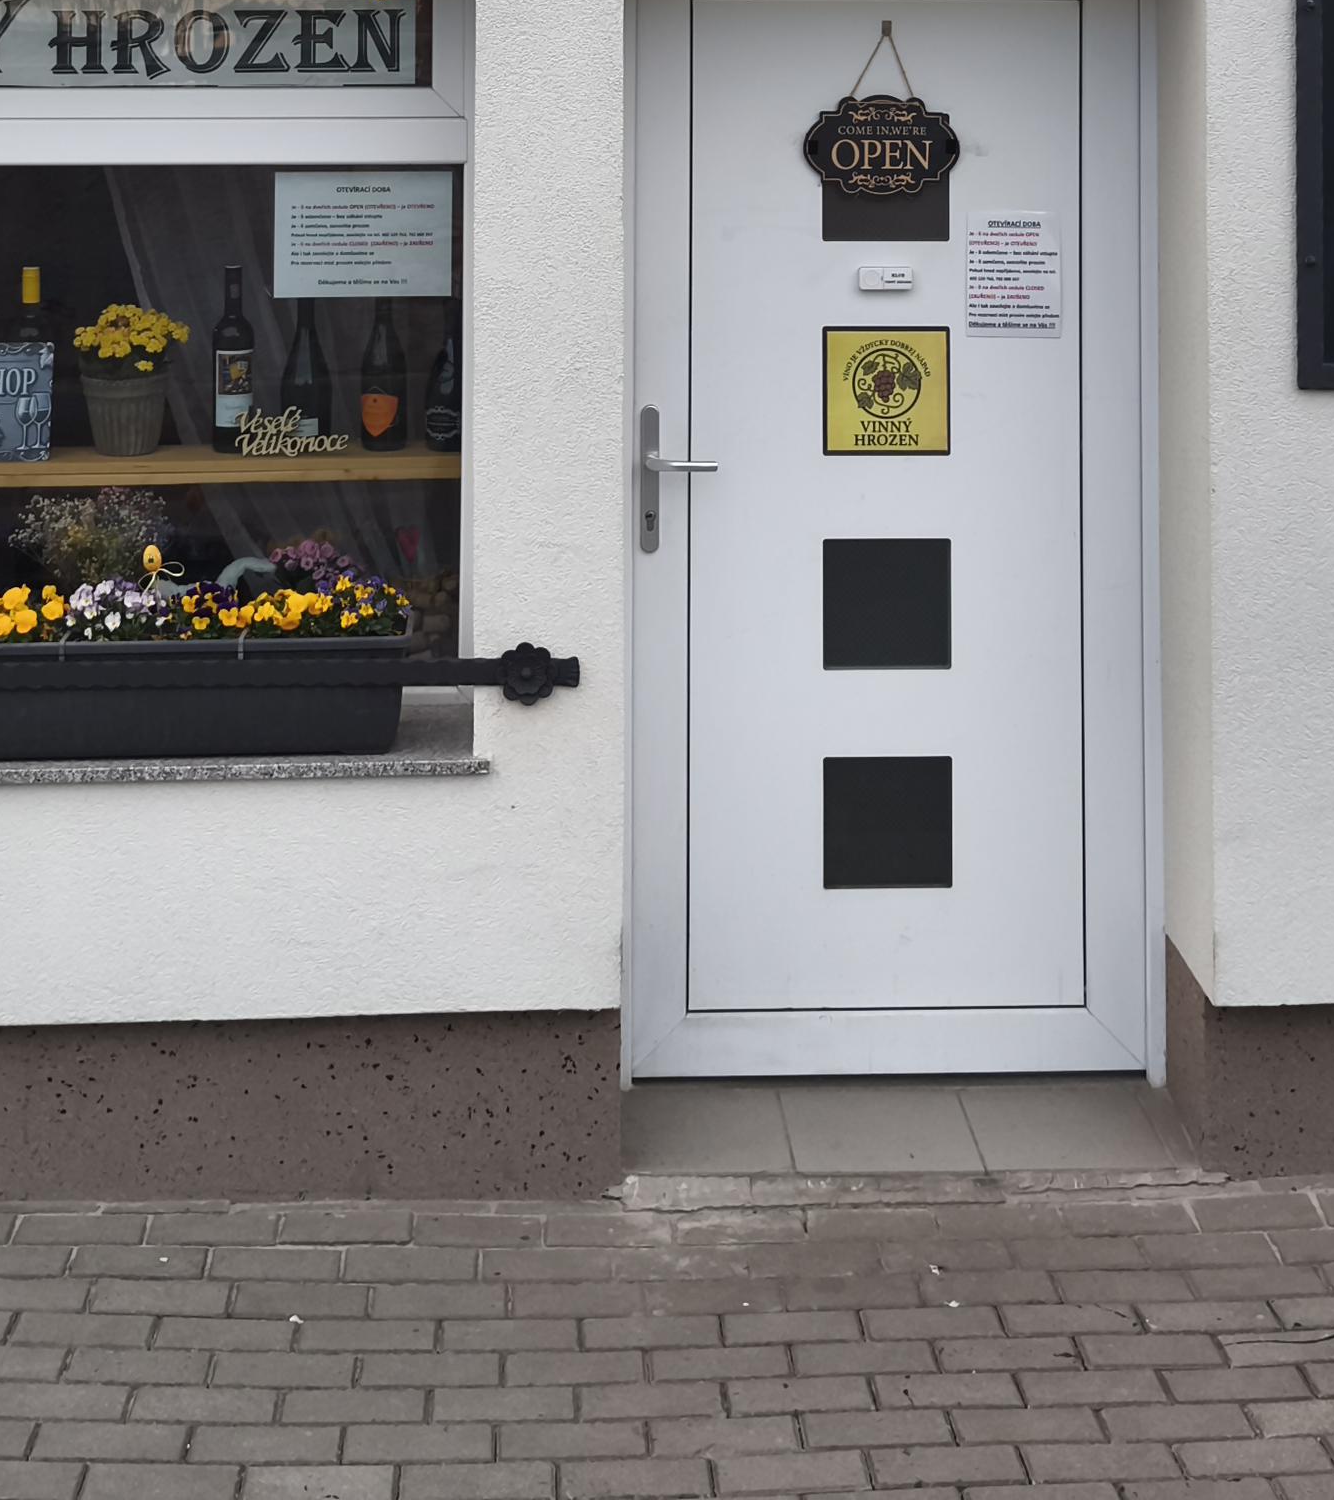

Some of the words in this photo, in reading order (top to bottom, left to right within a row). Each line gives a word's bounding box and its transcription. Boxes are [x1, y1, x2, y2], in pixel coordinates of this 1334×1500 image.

[48, 8, 406, 79] HROZEN
[837, 125, 874, 136] COME
[831, 139, 934, 170] OPEN
[235, 405, 303, 434] Veselé
[860, 418, 912, 433] VINNÝ
[235, 431, 349, 457] Velikonoce
[854, 434, 919, 446] HROZEN
